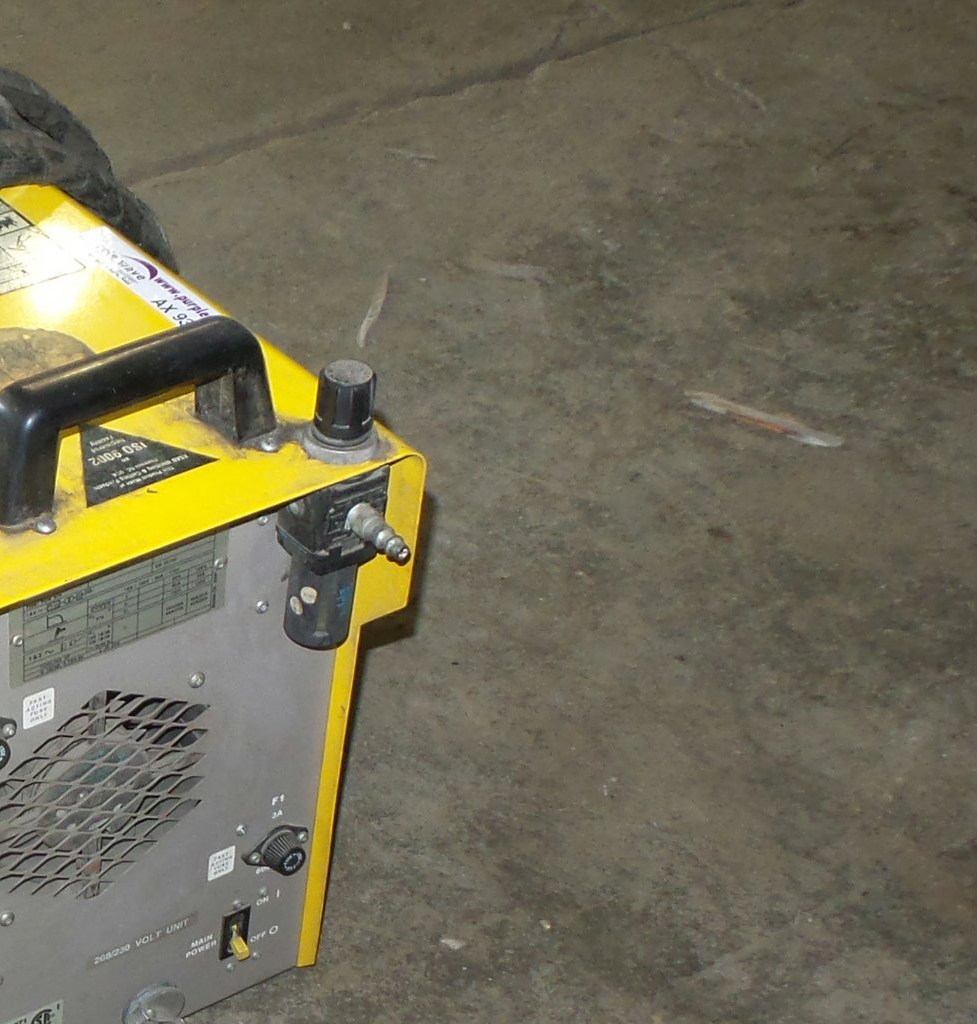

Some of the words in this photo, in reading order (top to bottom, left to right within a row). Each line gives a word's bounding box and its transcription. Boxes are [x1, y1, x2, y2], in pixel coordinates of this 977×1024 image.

[151, 299, 177, 314] AX
[121, 441, 148, 454] ISO
[88, 450, 123, 466] 9002
[271, 794, 285, 806] F1
[256, 896, 269, 906] ON
[135, 930, 161, 947] VOLT
[166, 918, 190, 934] UNIT
[249, 931, 266, 943] OFF
[191, 934, 214, 948] MAIN
[185, 940, 217, 959] POWER
